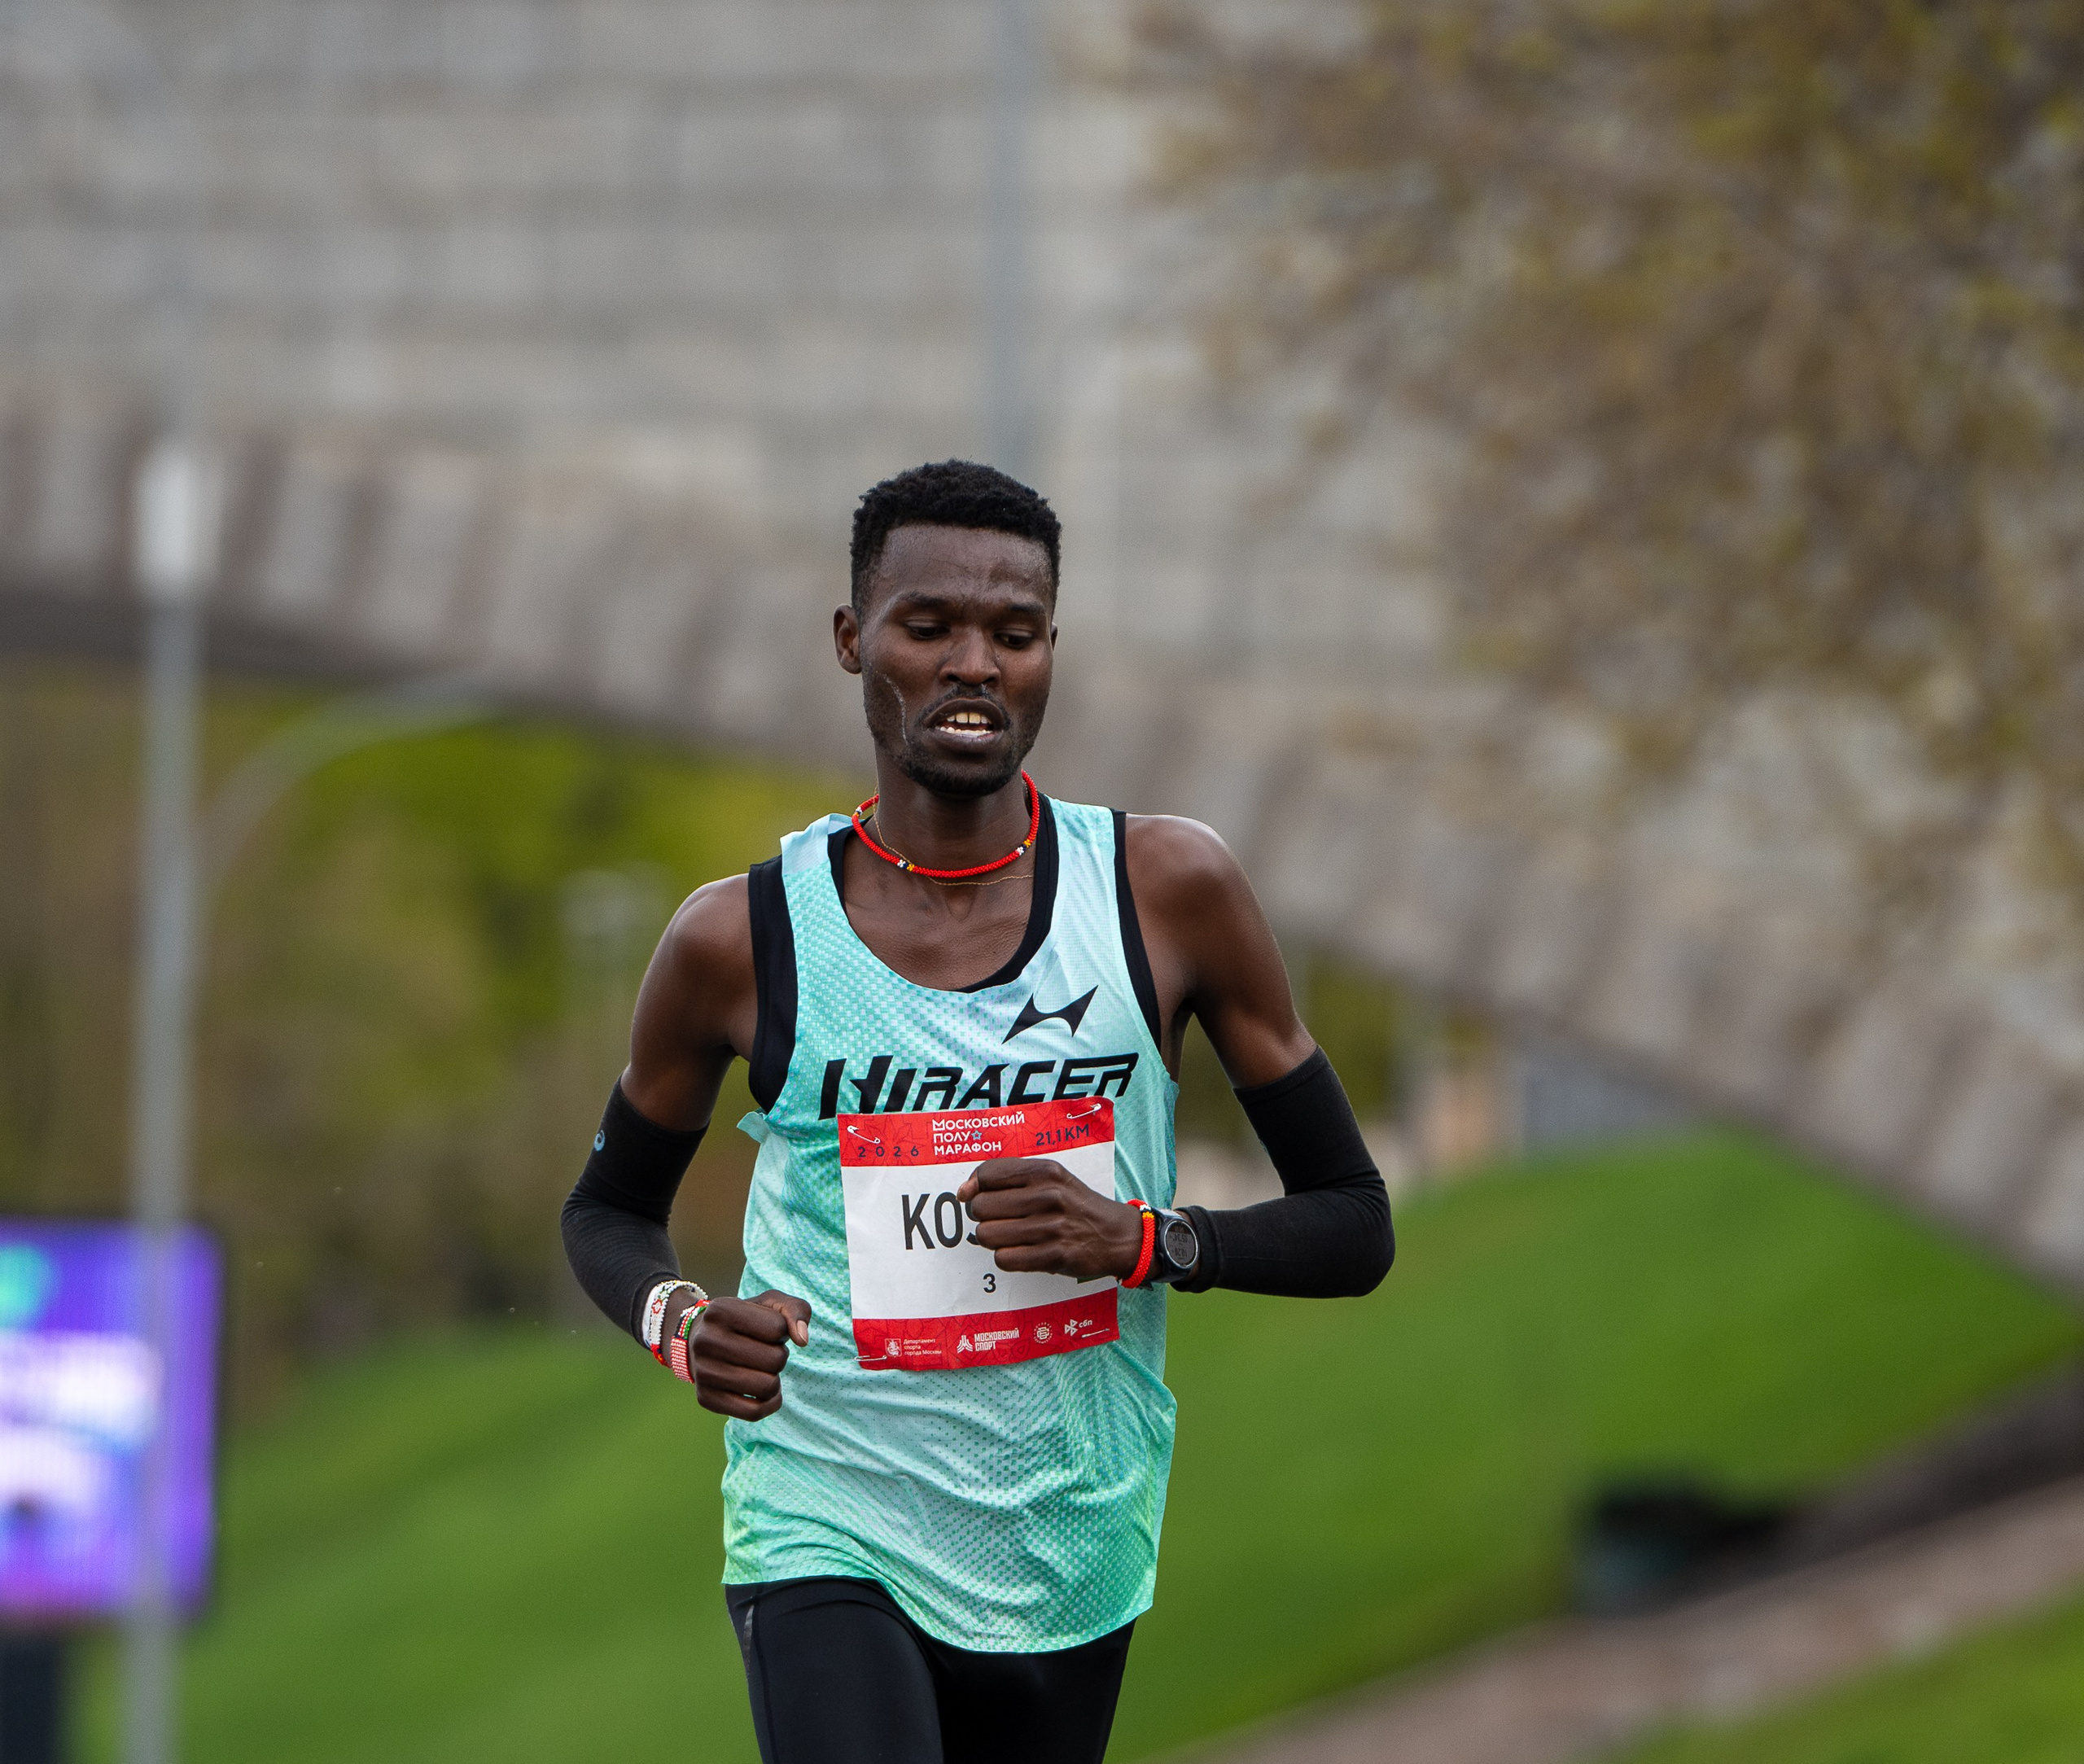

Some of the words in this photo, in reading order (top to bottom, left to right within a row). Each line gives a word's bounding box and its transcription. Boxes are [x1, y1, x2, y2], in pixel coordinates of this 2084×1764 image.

[819, 1053, 1139, 1120] HIRACER
[932, 1110, 1025, 1131] МОСКОВСКИЙ
[933, 1132, 970, 1143] ПОЛУ
[934, 1140, 1002, 1156] МАРАФОН
[983, 1273, 996, 1293] 3
[974, 1328, 1020, 1342] МОСКОВСКИЙ
[974, 1342, 996, 1352] СПОРТ
